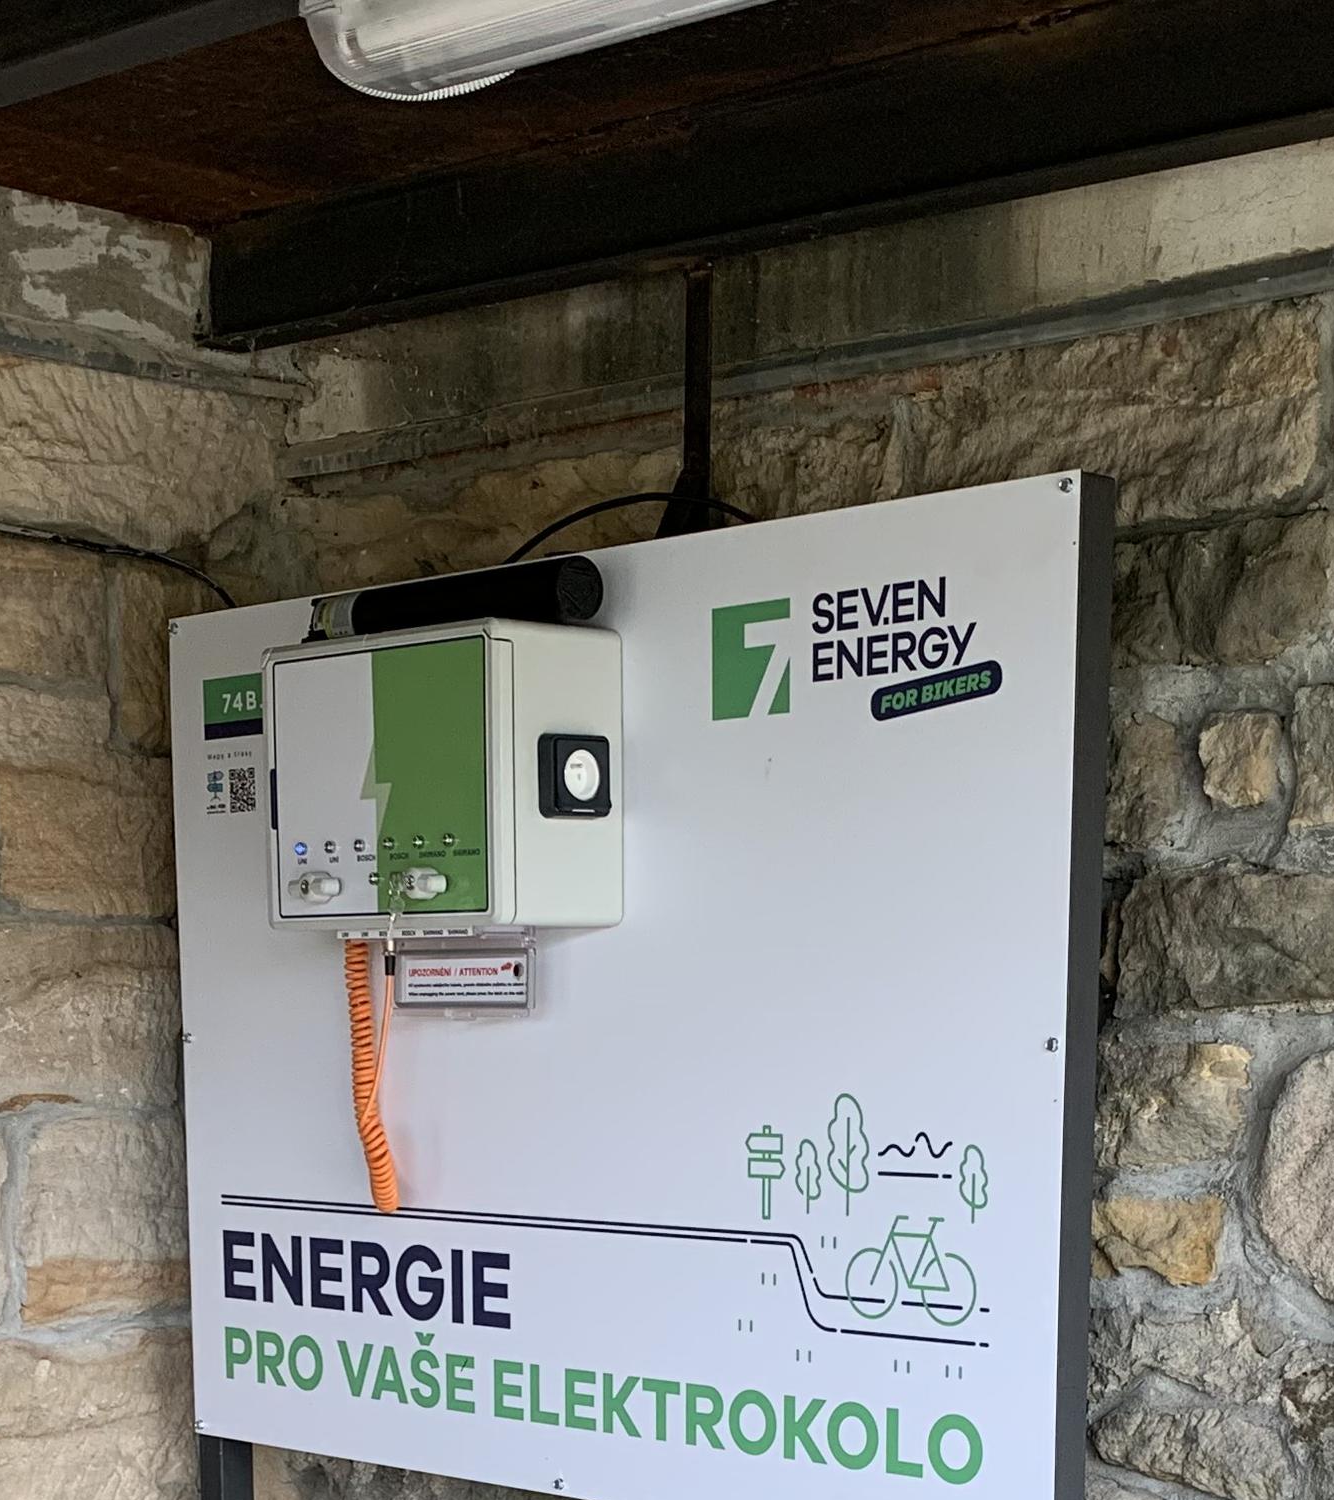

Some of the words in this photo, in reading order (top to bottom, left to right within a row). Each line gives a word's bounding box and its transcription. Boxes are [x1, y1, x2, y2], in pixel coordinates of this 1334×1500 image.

[811, 622, 977, 683] ENERGY
[879, 688, 918, 715] FOR
[920, 670, 993, 705] BIKERS
[357, 853, 376, 862] BOSCH
[389, 852, 409, 861] BOSCH
[459, 966, 499, 977] ATTENTION
[222, 1229, 512, 1330] ENERGIE
[224, 1326, 324, 1392] PRO
[337, 1332, 476, 1415] VAŠE
[493, 1359, 985, 1486] ELEKTROKOLO
